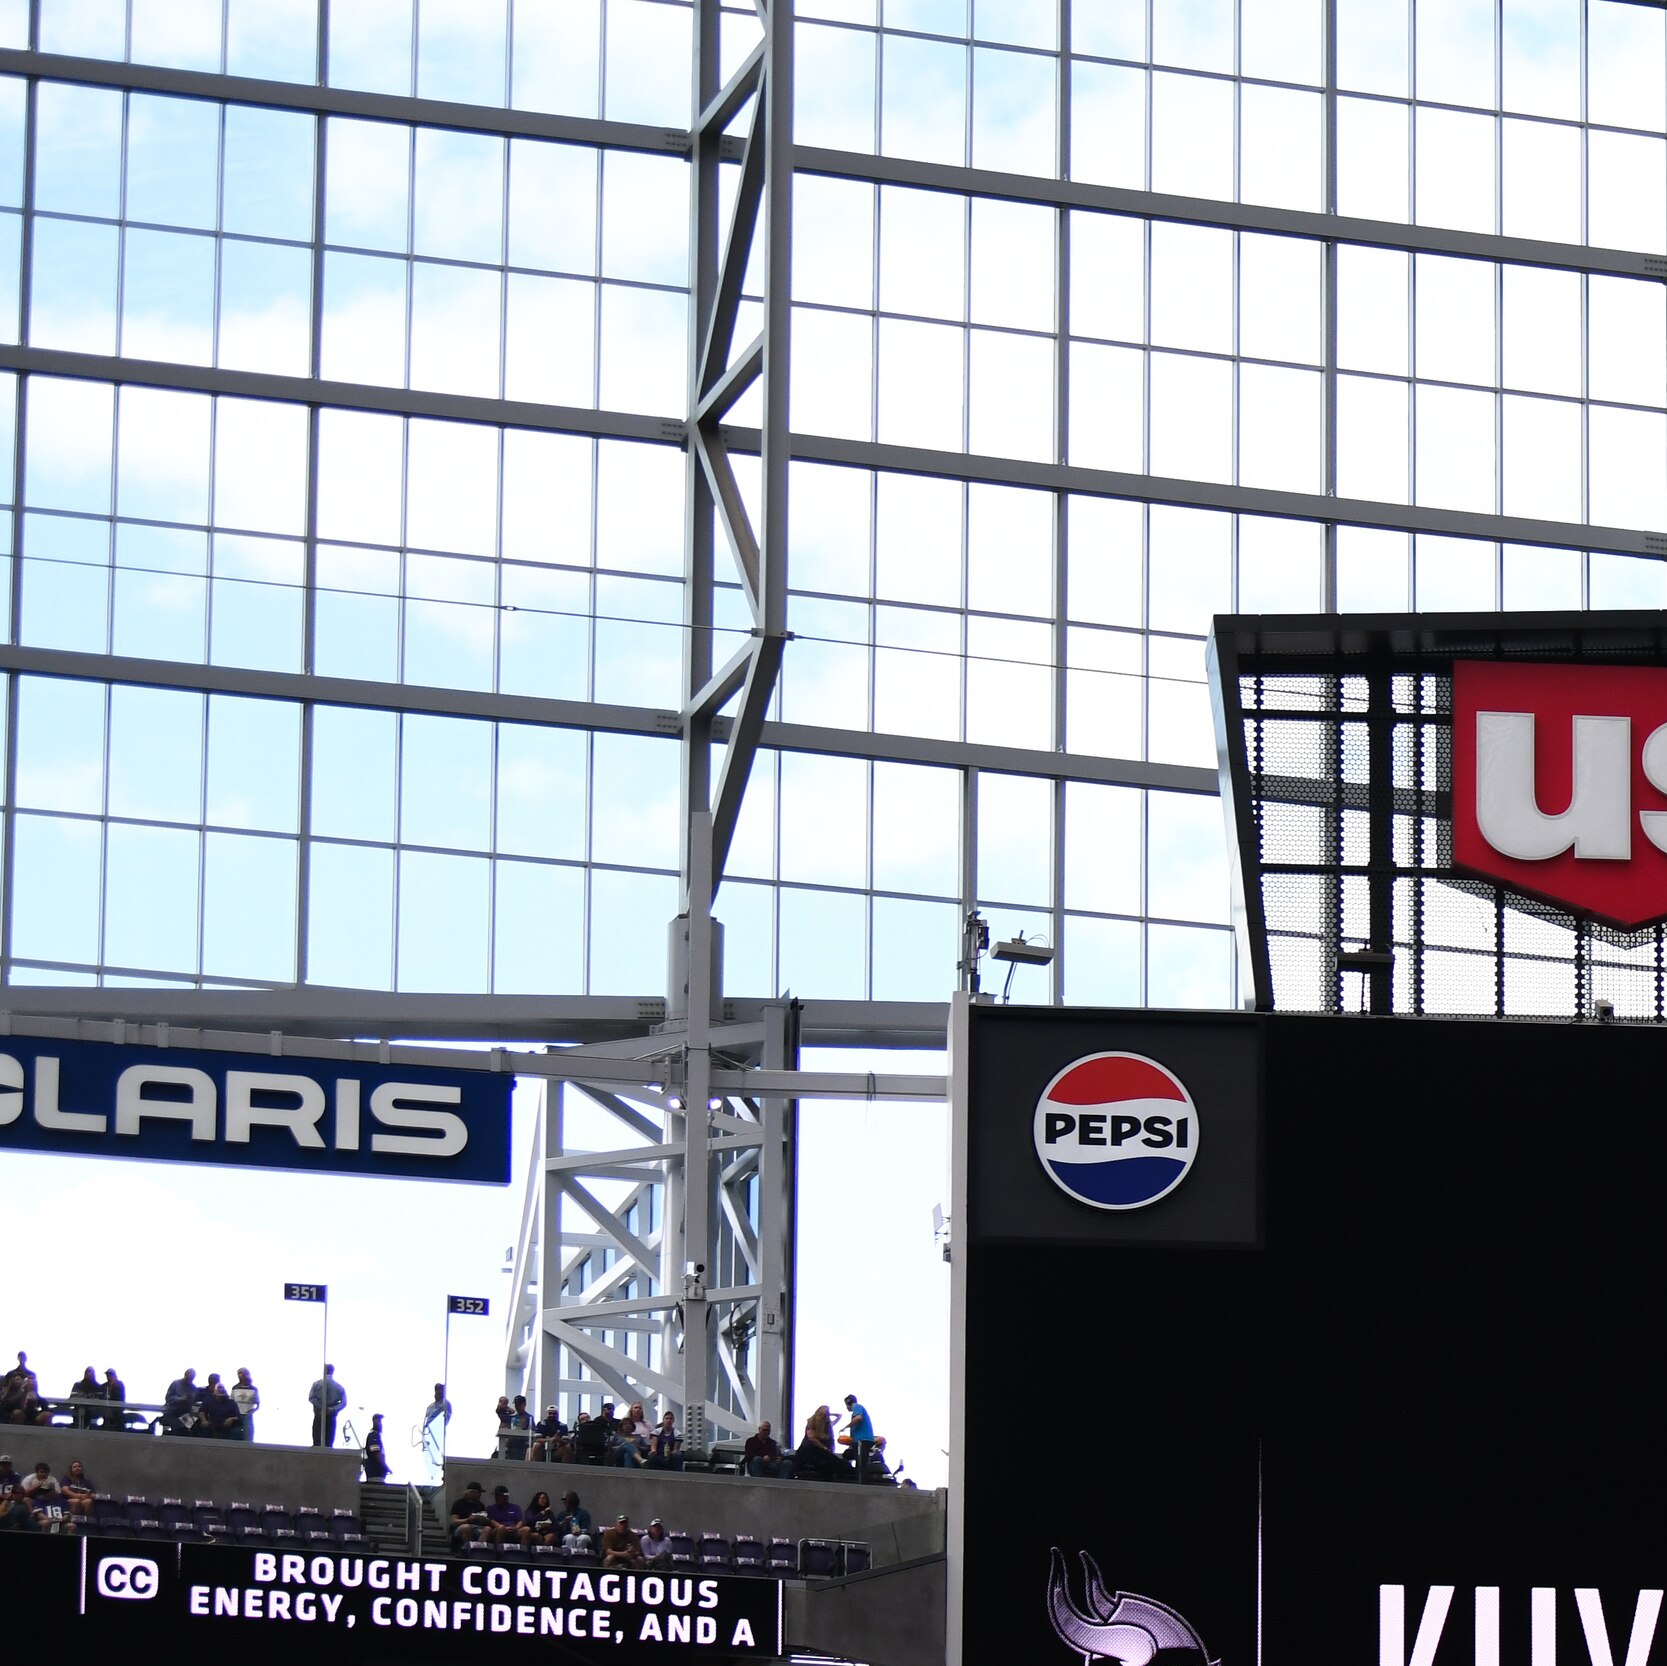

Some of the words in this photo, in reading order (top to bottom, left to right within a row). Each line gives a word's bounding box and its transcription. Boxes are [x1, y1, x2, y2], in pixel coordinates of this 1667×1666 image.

[1045, 1112, 1189, 1150] PEPSI
[291, 1285, 318, 1300] 351
[455, 1298, 484, 1314] 352
[46, 1506, 62, 1519] 18
[104, 1563, 152, 1595] CC
[255, 1553, 447, 1592] BROUGHT
[462, 1566, 719, 1608] CONTAGIOUS
[190, 1585, 356, 1628] ENERGY,
[372, 1597, 624, 1644] CONFIDENCE,
[639, 1613, 717, 1644] AND
[731, 1618, 756, 1647] A
